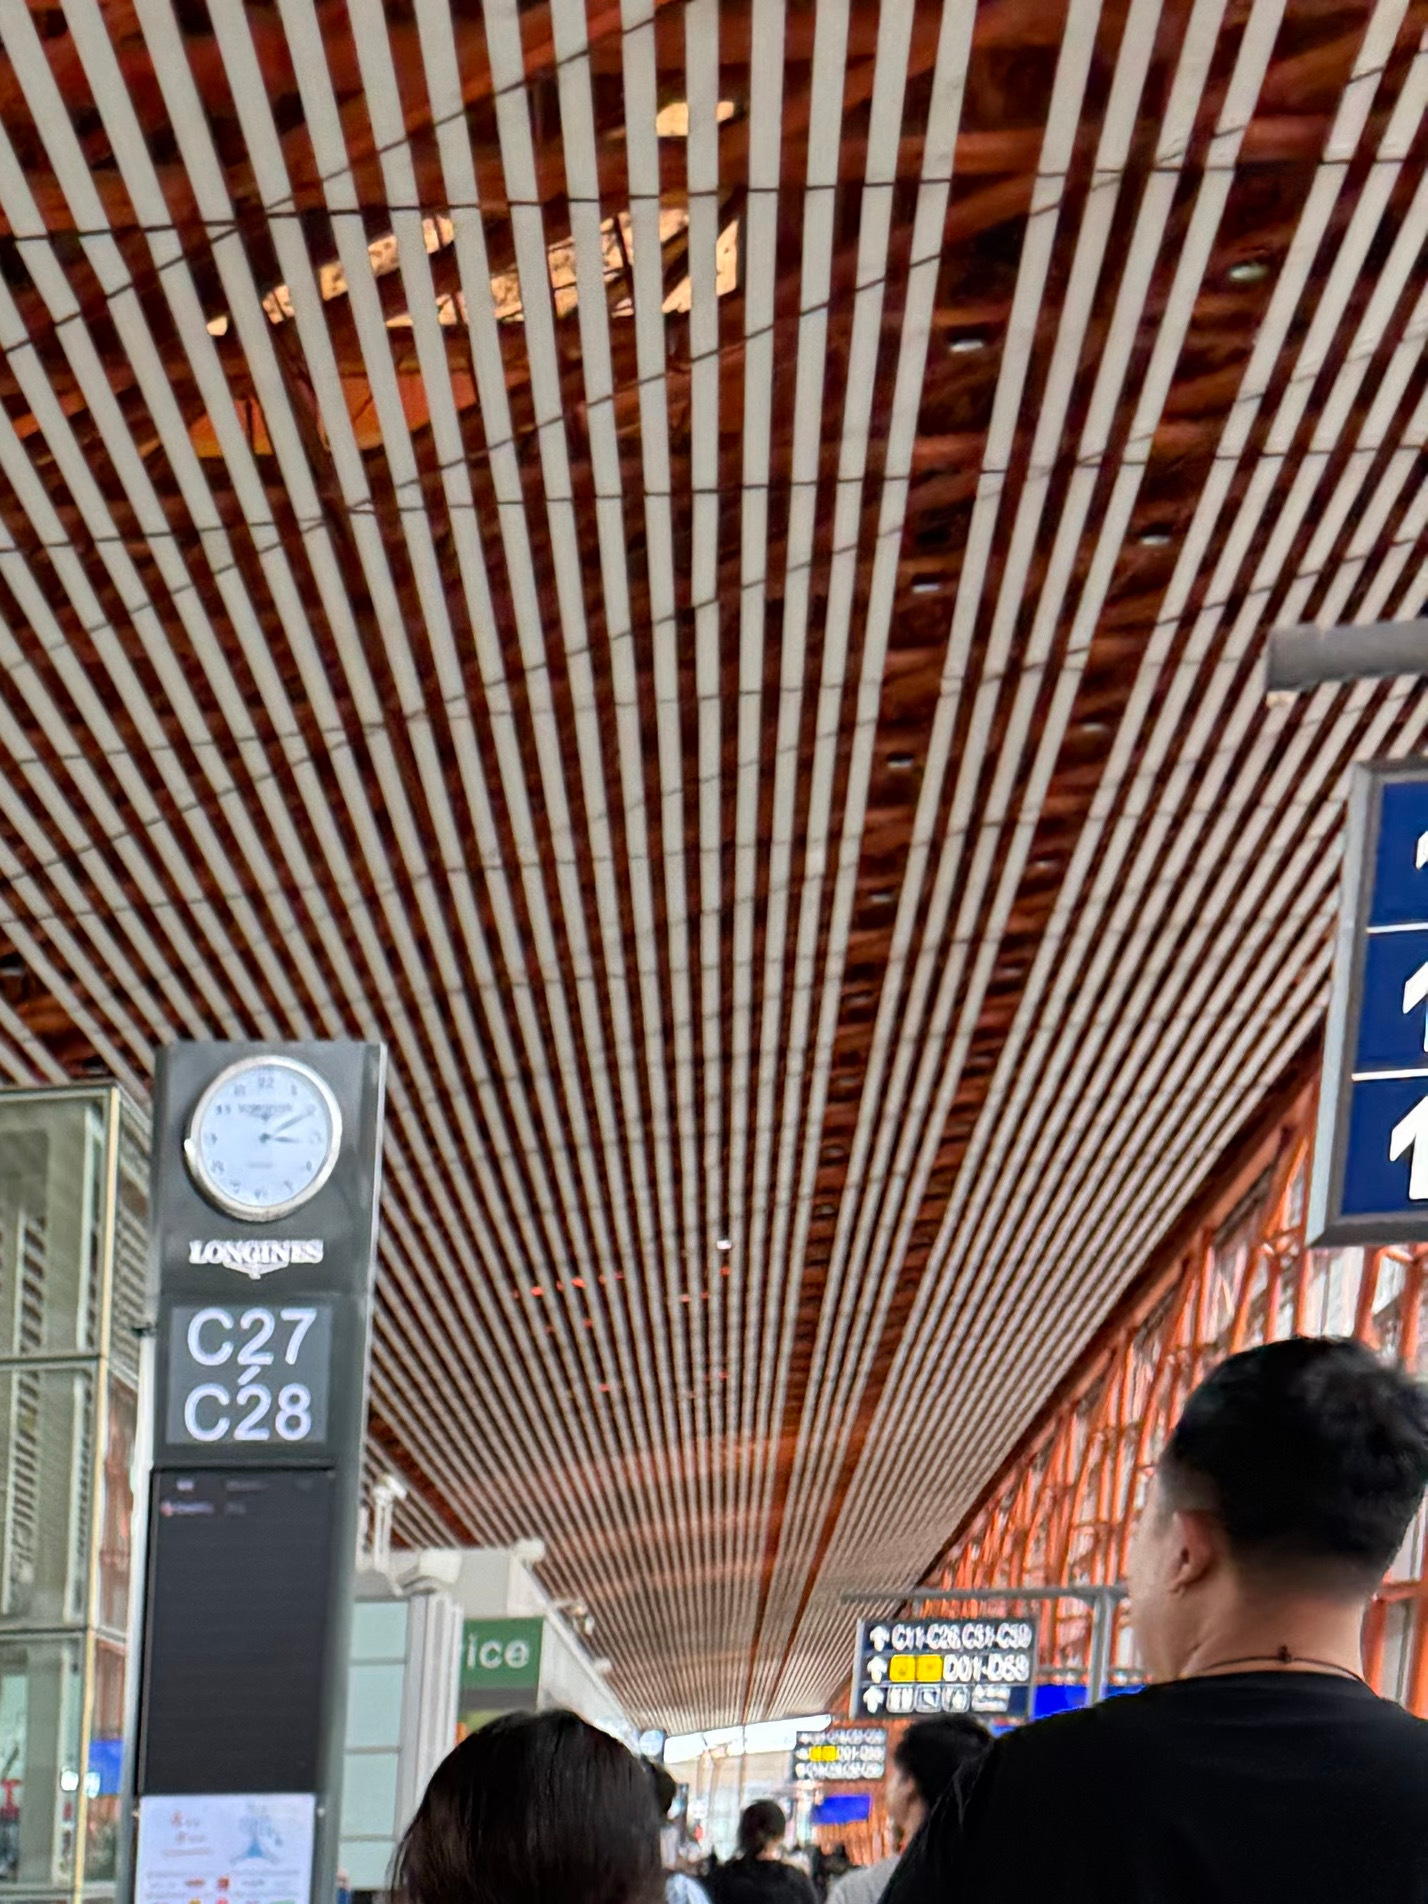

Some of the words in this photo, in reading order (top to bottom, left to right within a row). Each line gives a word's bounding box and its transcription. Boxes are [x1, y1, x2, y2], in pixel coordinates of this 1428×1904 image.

[188, 1239, 325, 1267] LONGINES
[186, 1307, 318, 1367] C27
[183, 1383, 313, 1443] C28
